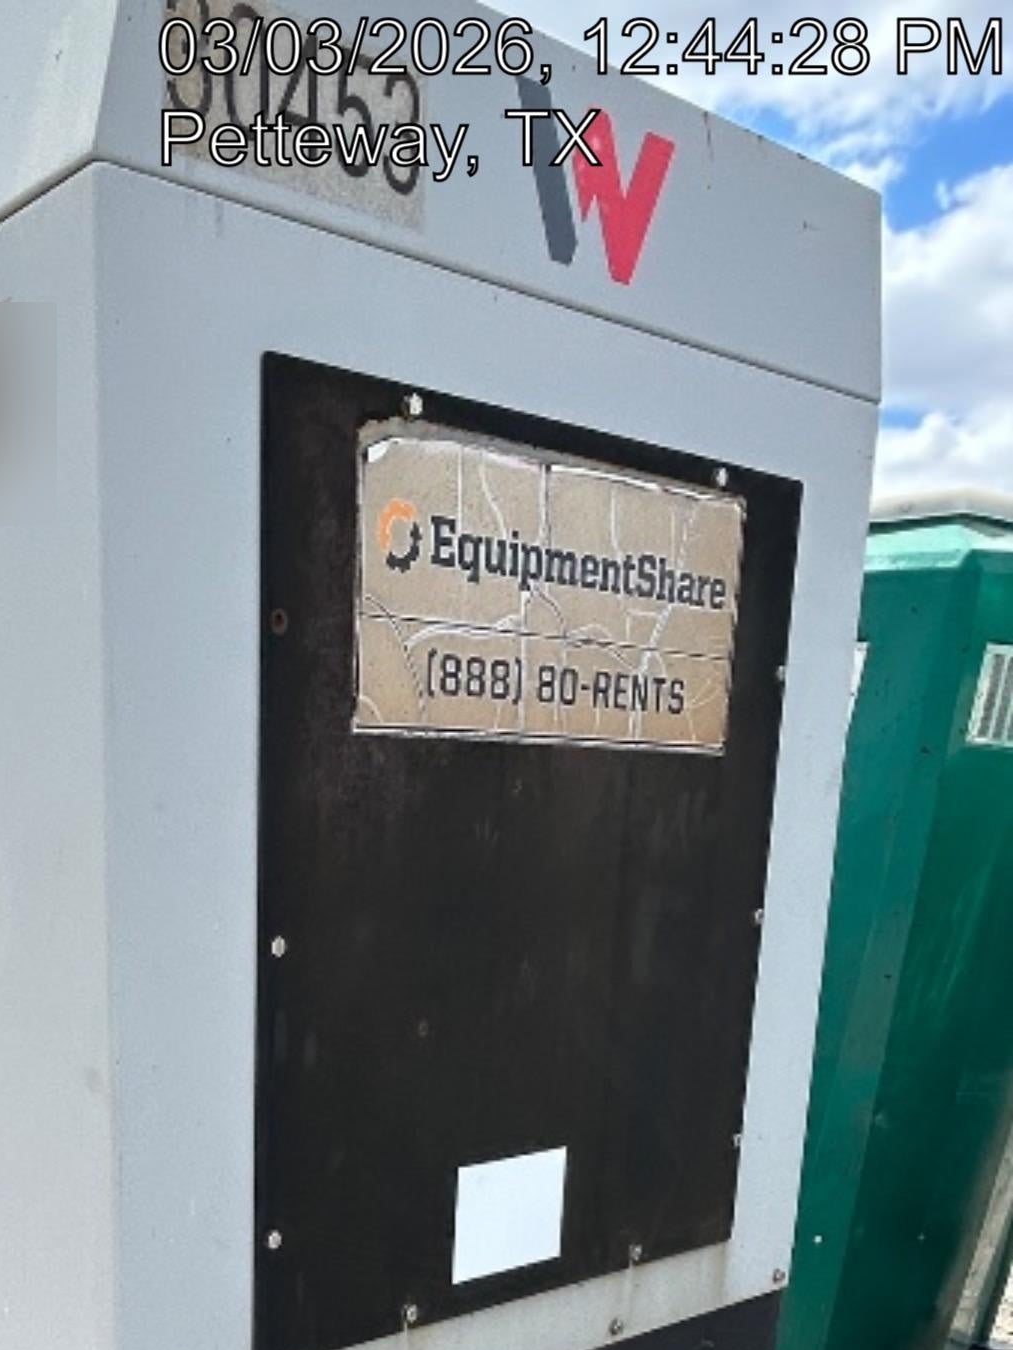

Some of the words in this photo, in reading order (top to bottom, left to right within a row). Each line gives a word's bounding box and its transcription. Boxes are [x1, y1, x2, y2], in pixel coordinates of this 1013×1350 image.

[430, 515, 727, 610] EquipmentShare
[426, 648, 524, 706] (888)
[537, 664, 685, 715] 80-RENTS
